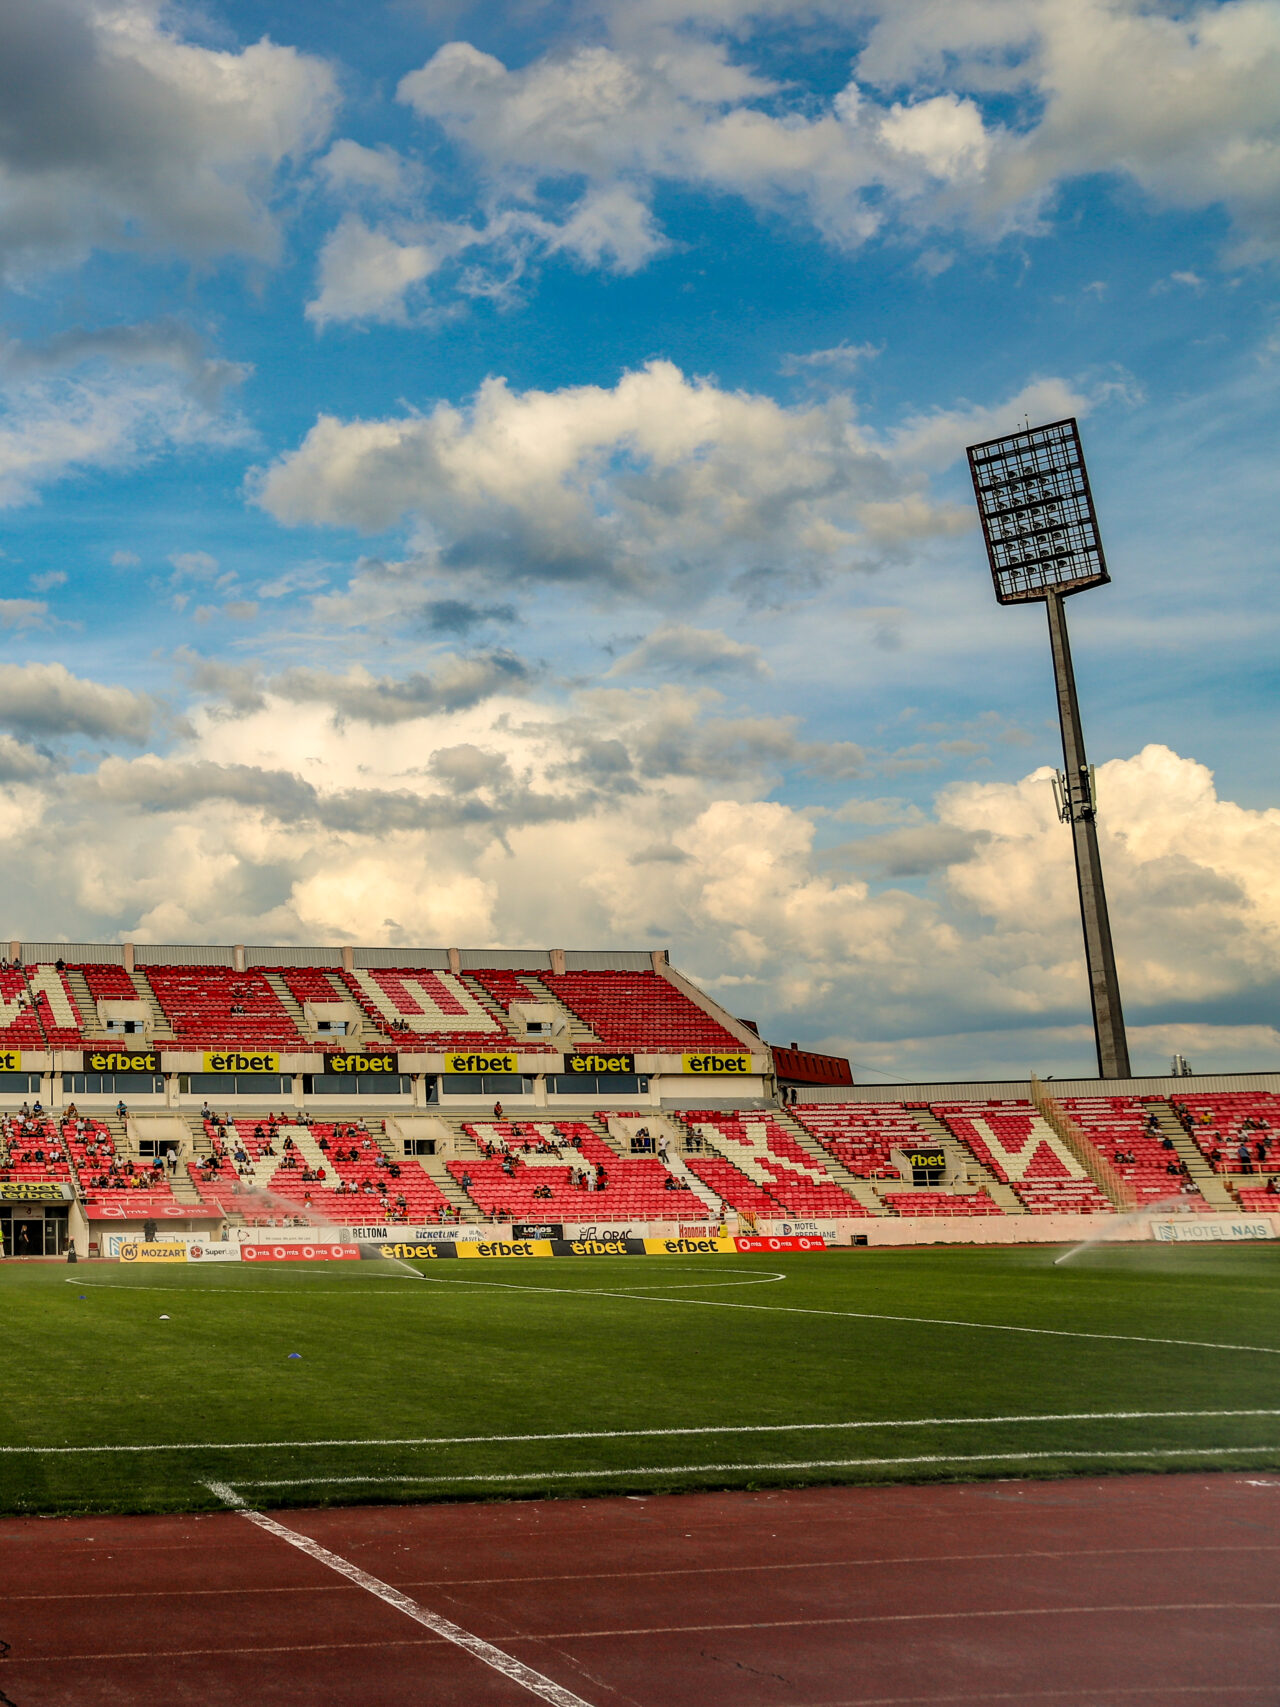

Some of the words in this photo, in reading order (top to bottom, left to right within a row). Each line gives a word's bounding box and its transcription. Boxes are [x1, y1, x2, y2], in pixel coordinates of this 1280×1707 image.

[90, 1053, 156, 1070] efbet
[209, 1053, 273, 1070] efbet
[330, 1055, 394, 1072] efbet
[451, 1055, 512, 1072] efbet
[570, 1055, 630, 1072] efbet
[688, 1055, 747, 1072] efbet
[910, 1154, 945, 1167] fbet
[3, 1183, 61, 1191] efbet
[3, 1191, 62, 1200] efbet
[352, 1227, 388, 1239] BELTONA
[794, 1222, 819, 1230] MOTEL
[1182, 1226, 1229, 1237] HOTEL
[1231, 1225, 1268, 1236] NAIS
[141, 1249, 187, 1257] MOZZART
[379, 1243, 438, 1259] efbet
[476, 1242, 534, 1256] efbet
[570, 1240, 627, 1255] efbet
[664, 1239, 719, 1253] efbet
